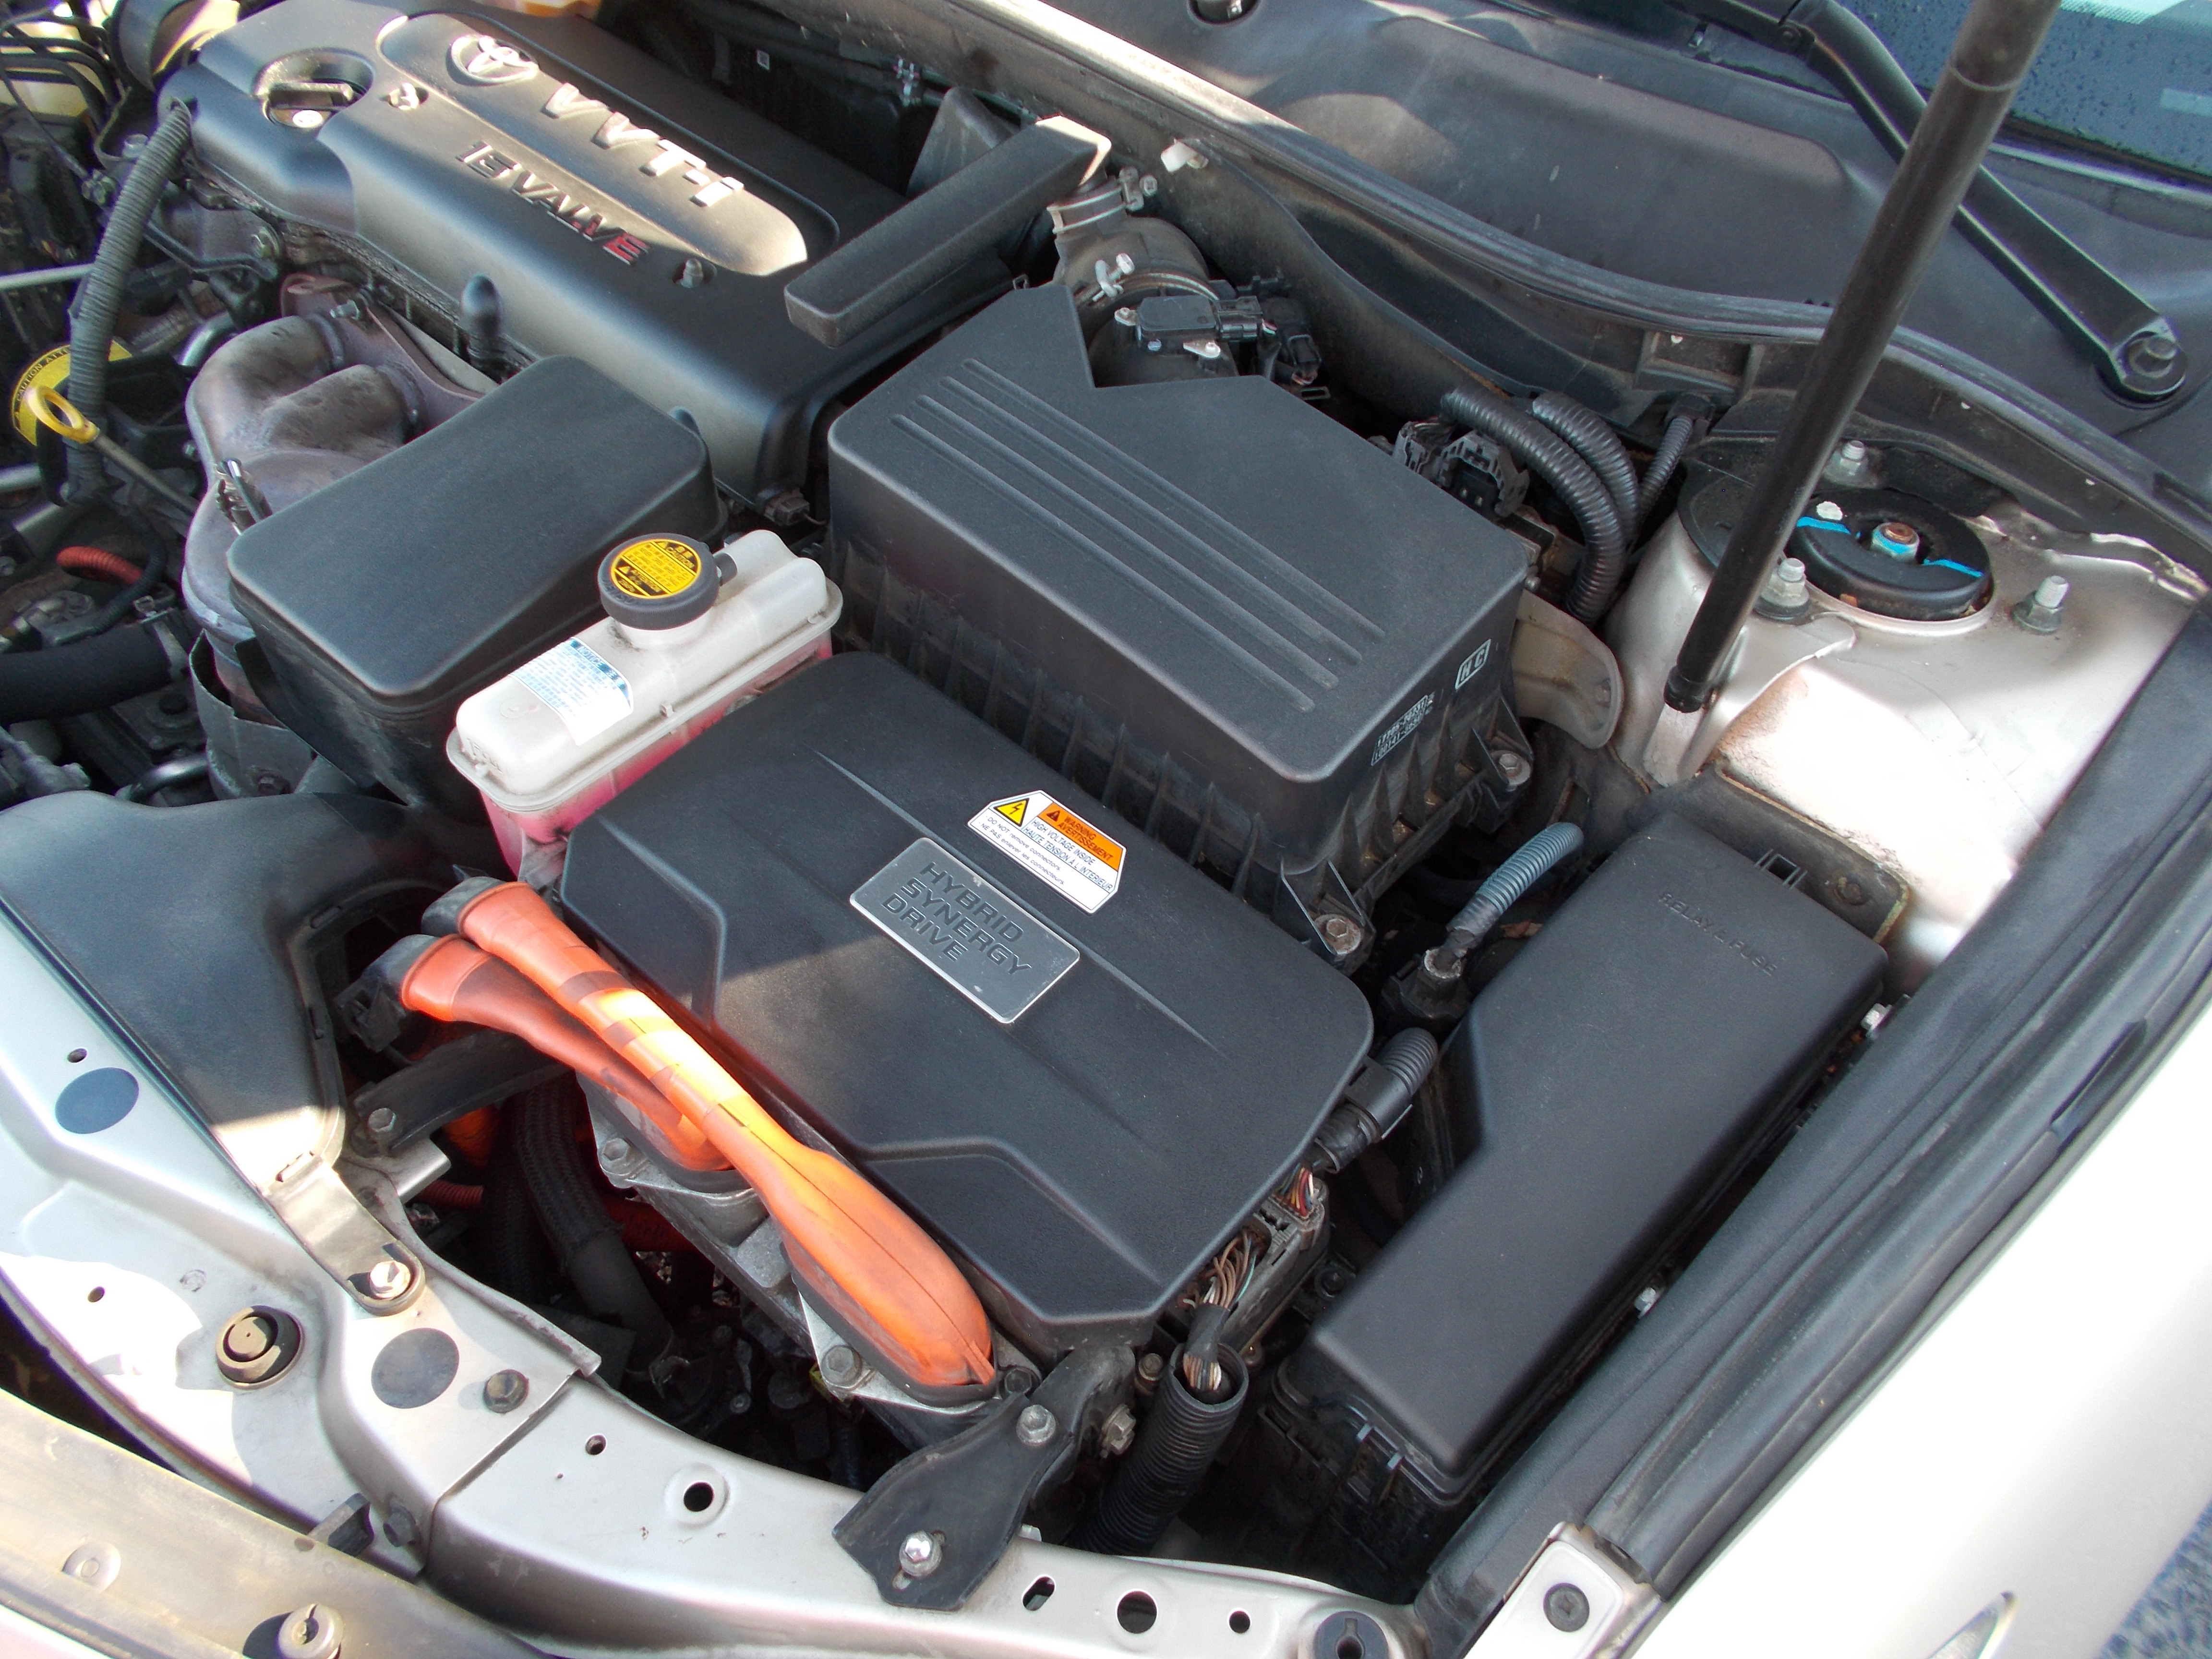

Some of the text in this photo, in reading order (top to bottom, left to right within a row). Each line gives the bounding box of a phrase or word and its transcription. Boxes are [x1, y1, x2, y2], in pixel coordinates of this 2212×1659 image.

[511, 169, 649, 265] VALVE
[577, 645, 603, 668] NOTICE
[989, 830, 1002, 839] PAS
[1001, 838, 1022, 854] enlever
[1022, 853, 1030, 861] les
[997, 824, 1011, 834] NOT
[1009, 833, 1030, 849] remove
[1029, 848, 1061, 872] connectors.
[1023, 827, 1045, 843] HAUTE
[1044, 841, 1070, 861] TENSION
[1031, 820, 1095, 866] HIGH VOLTAGE INSIDE
[1058, 822, 1114, 862] AVERTISSEMENT
[1063, 815, 1096, 841] WARNING
[919, 862, 1023, 942] HYBRID
[881, 893, 969, 962] DRIVE
[901, 878, 1032, 975] SYNERGY
